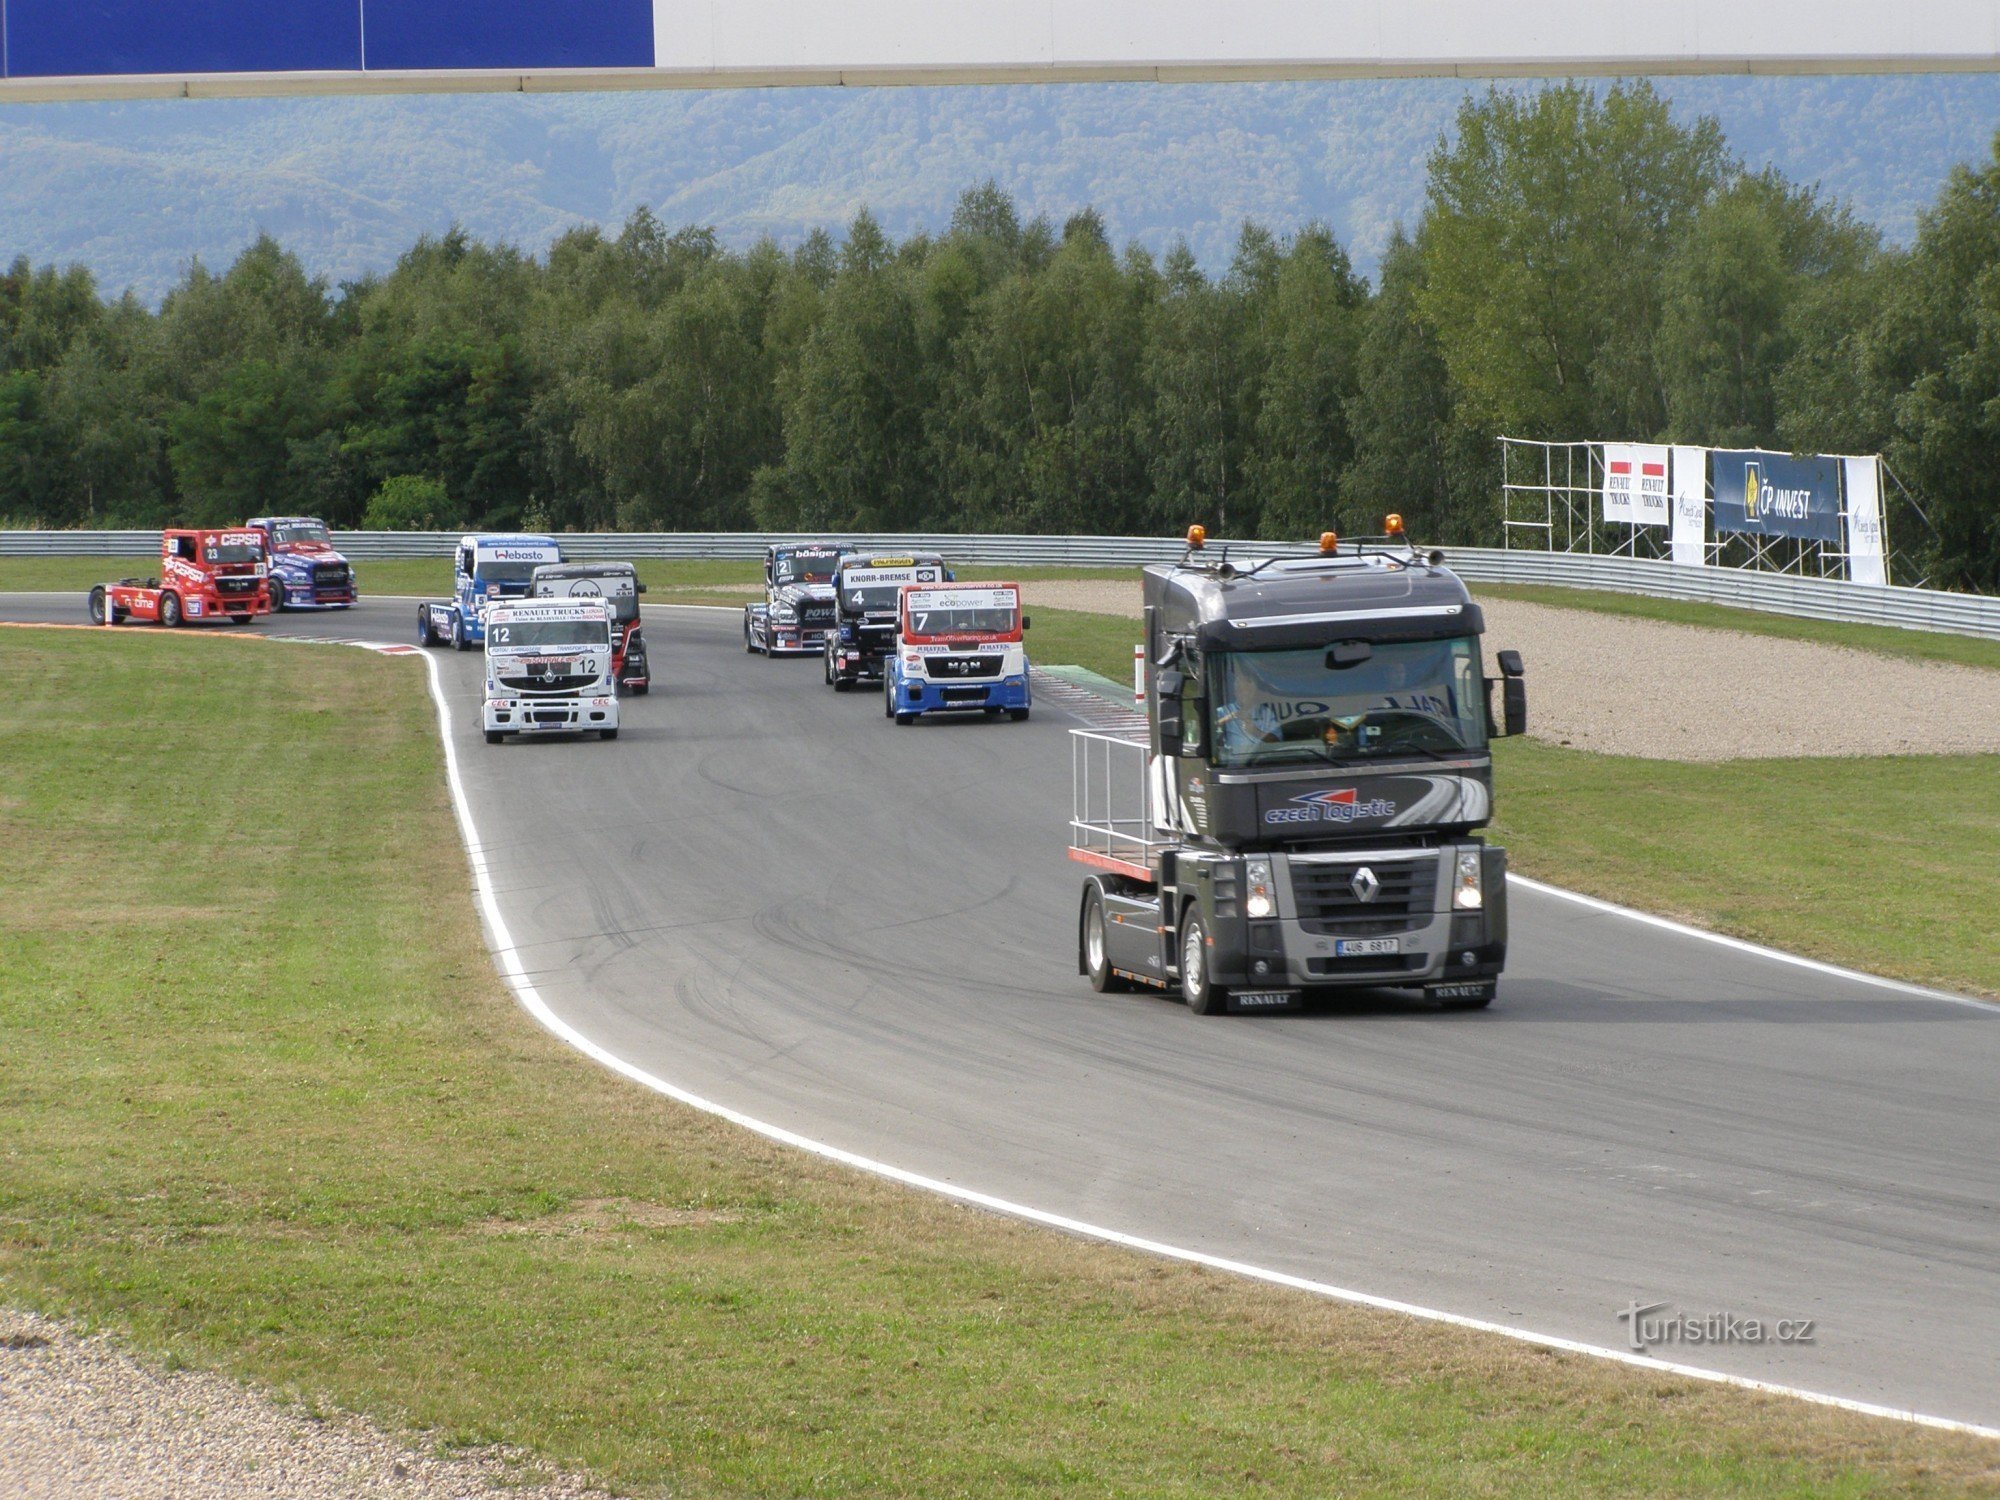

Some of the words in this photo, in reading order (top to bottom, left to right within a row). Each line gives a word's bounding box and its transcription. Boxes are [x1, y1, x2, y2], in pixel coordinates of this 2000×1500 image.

[1609, 476, 1631, 490] RENAULT
[1641, 478, 1664, 493] RENAULT
[1642, 494, 1664, 508] TRUCKS
[1761, 478, 1773, 515] ČP
[1775, 489, 1811, 519] INVEST
[221, 534, 261, 546] CEPSA
[207, 548, 218, 560] 23
[495, 550, 544, 560] Webasto
[779, 562, 787, 573] 2
[850, 573, 911, 583] KNORR-BREMSE
[478, 596, 485, 605] 5
[851, 590, 865, 605] 4
[939, 599, 984, 608] ecopower
[916, 612, 929, 631] 7
[492, 628, 510, 643] 12
[580, 659, 596, 674] 12
[947, 661, 981, 669] MAN
[1264, 803, 1321, 824] czech
[1322, 800, 1396, 823] logistic
[1435, 985, 1485, 999] RENAULT
[1239, 993, 1291, 1006] RENAULT
